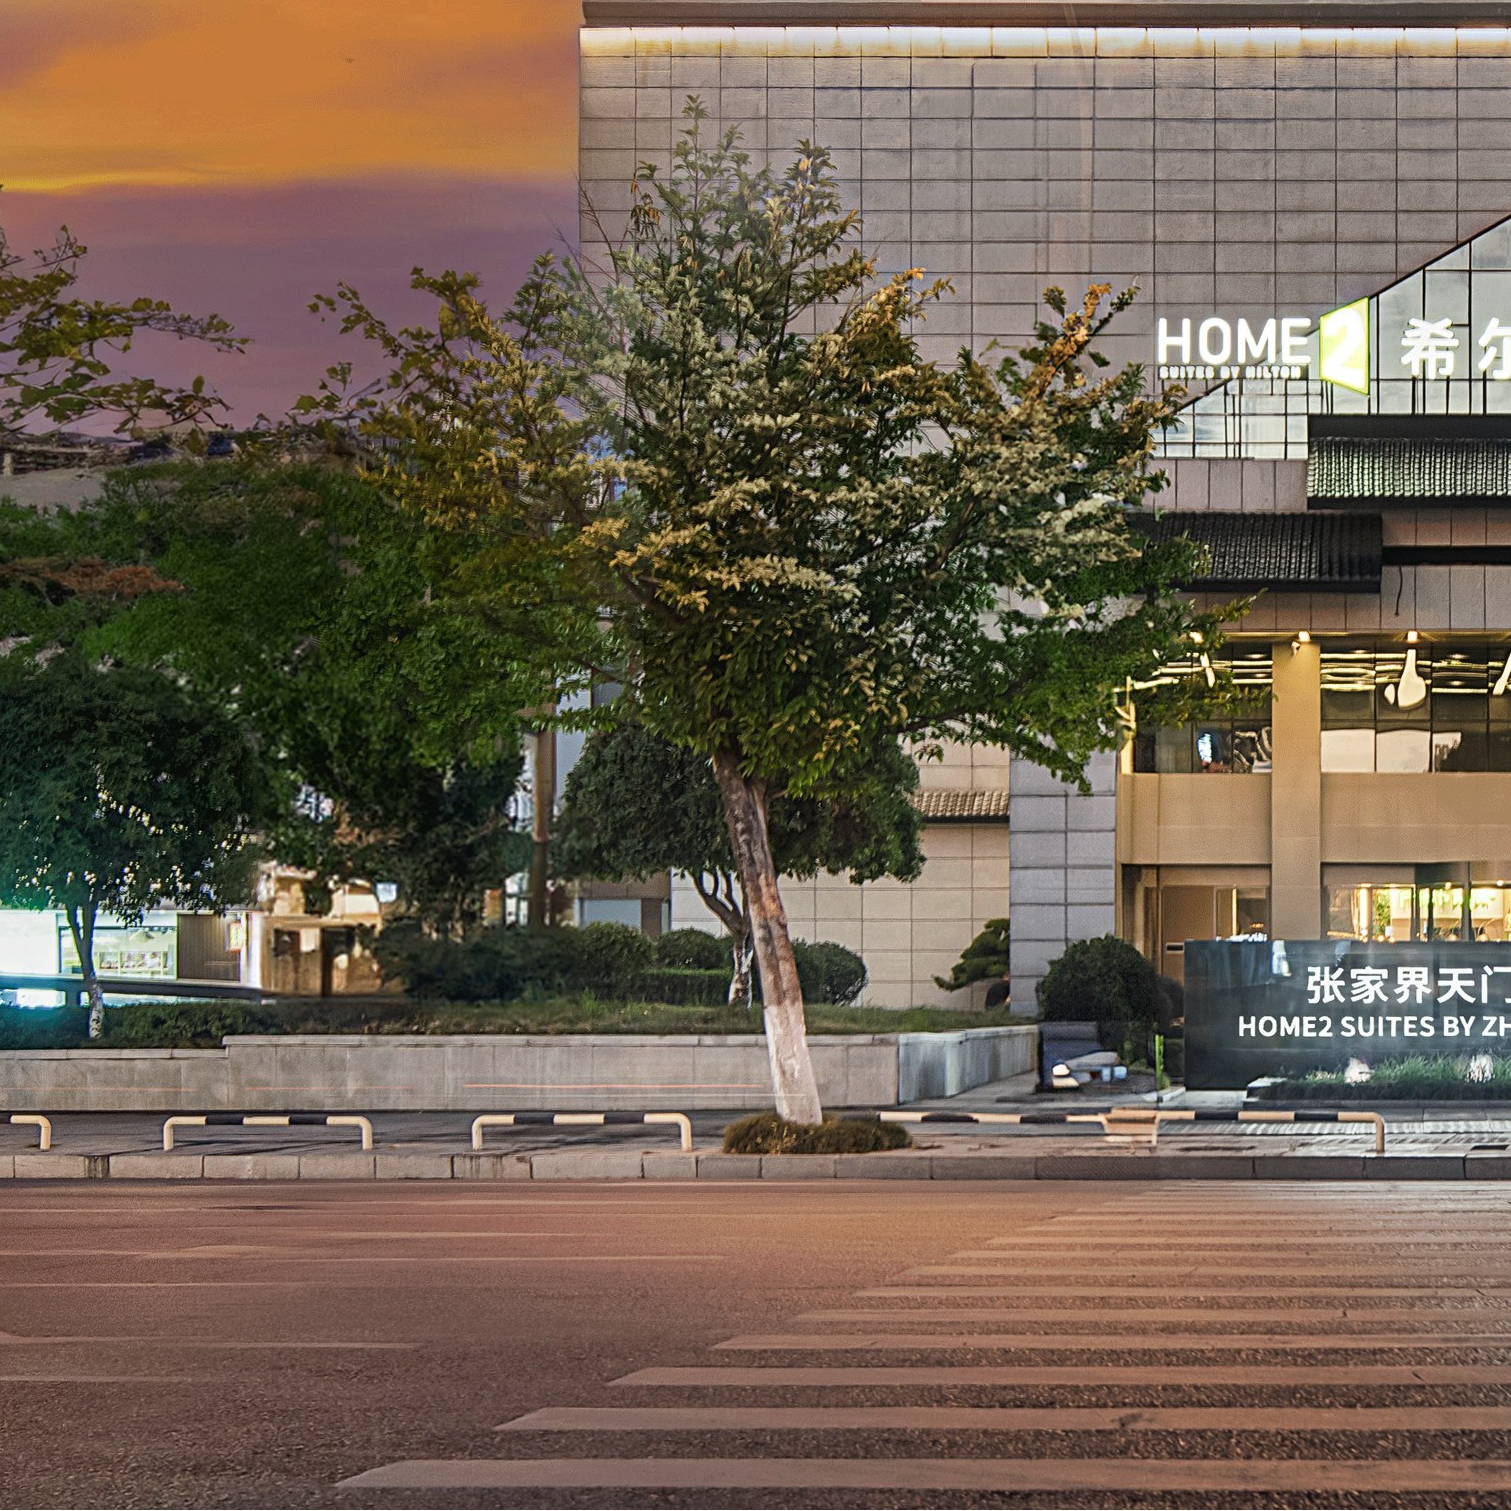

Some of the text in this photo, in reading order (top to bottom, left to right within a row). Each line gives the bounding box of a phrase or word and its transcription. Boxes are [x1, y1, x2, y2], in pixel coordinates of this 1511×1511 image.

[1245, 366, 1301, 379] HILTON
[1238, 1015, 1333, 1038] HOME2
[1340, 1015, 1435, 1038] SUITES
[1443, 1015, 1476, 1037] BY
